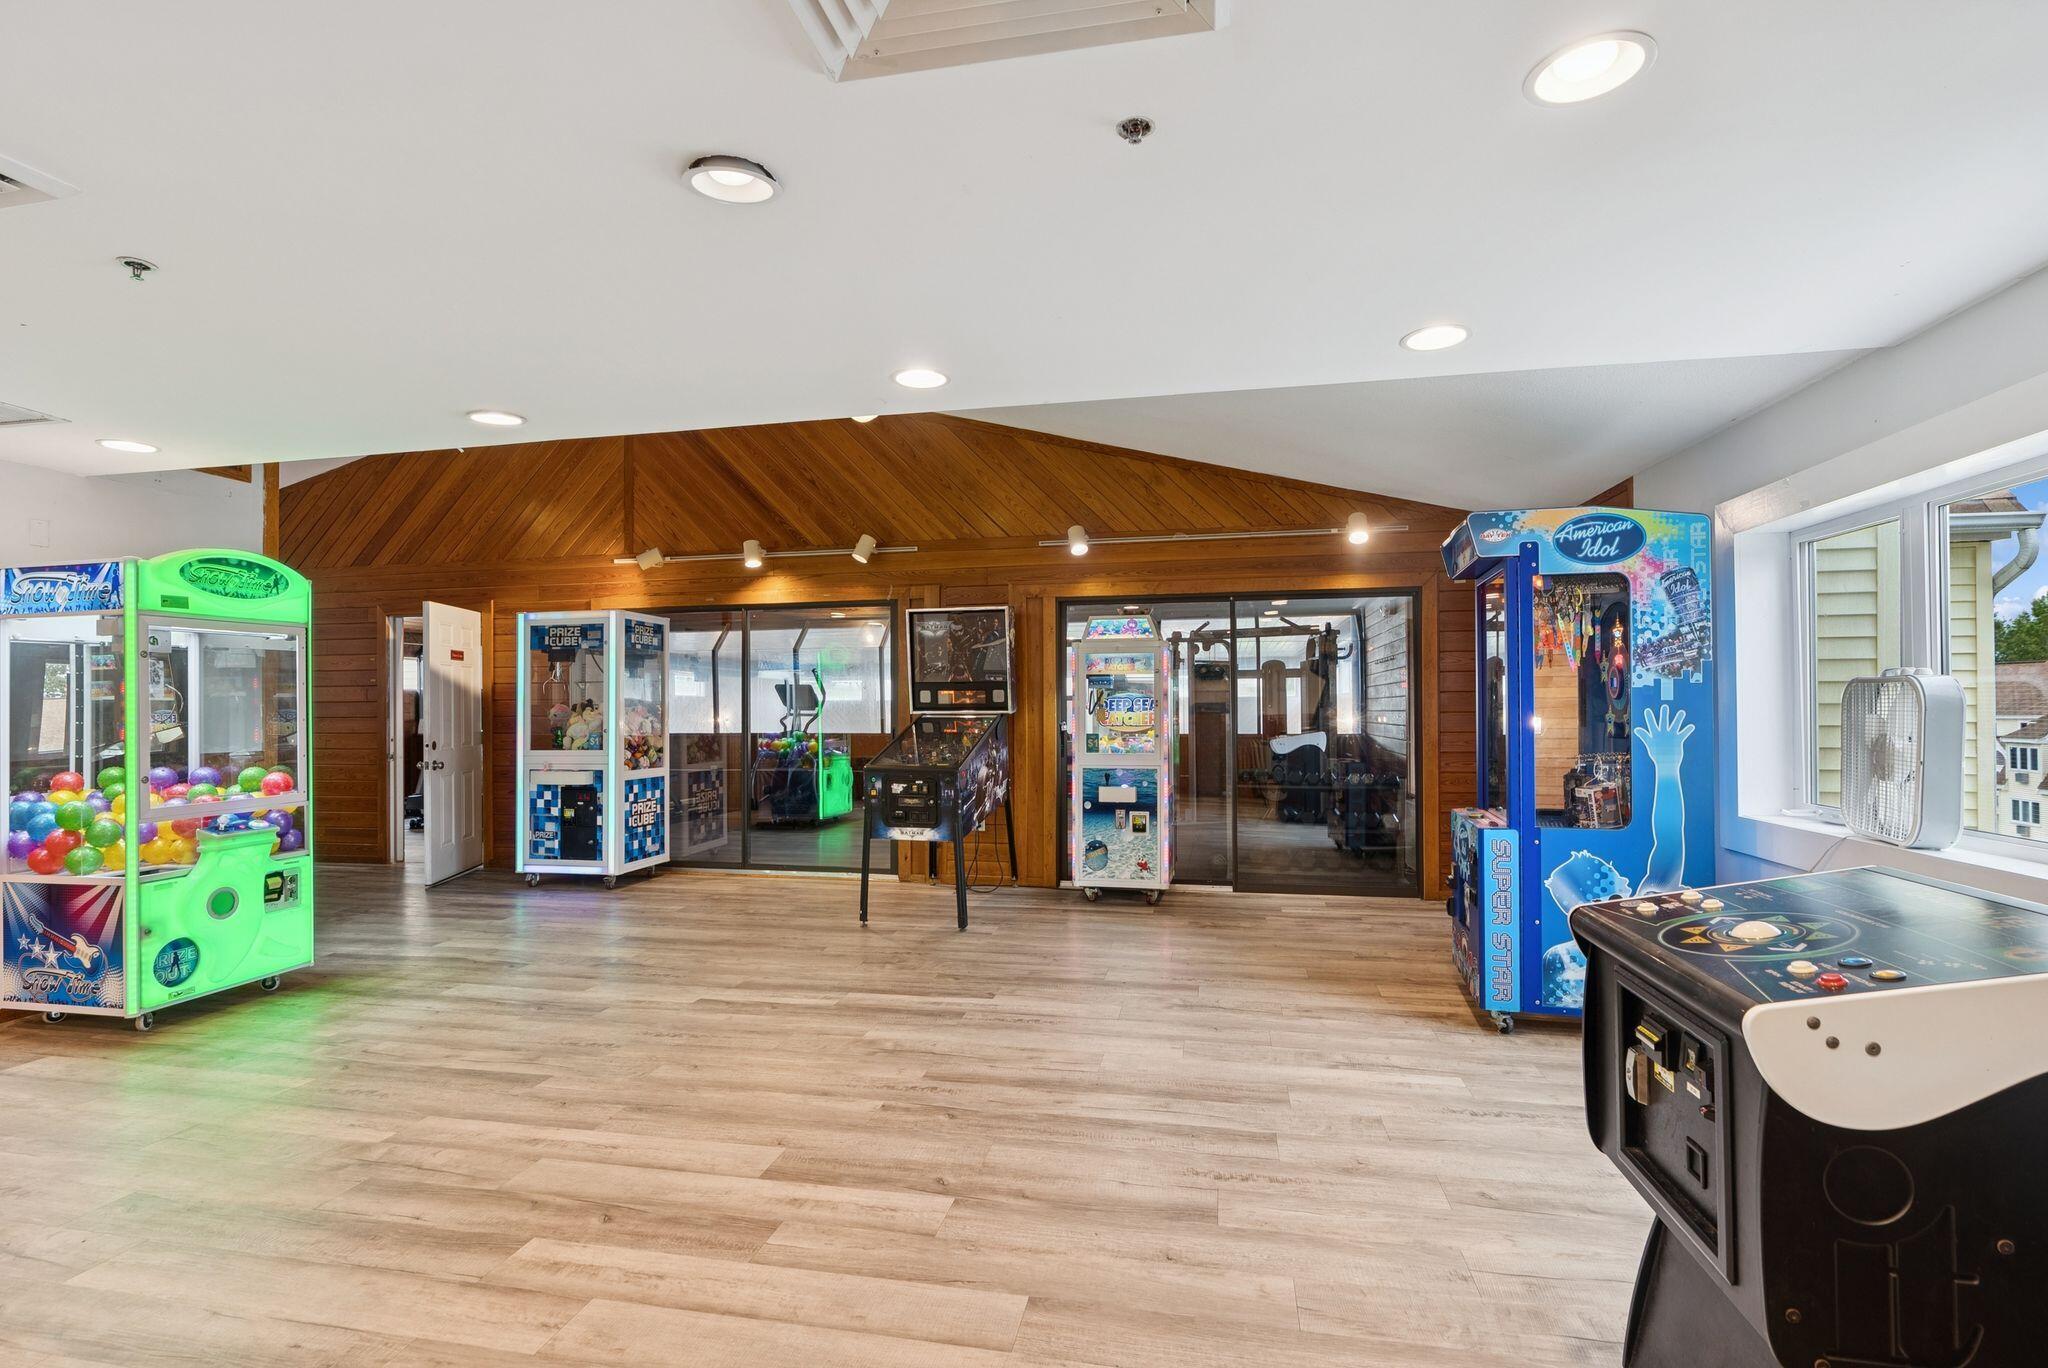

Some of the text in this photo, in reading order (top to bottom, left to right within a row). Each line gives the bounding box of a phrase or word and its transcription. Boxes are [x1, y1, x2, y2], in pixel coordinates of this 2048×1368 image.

[1554, 521, 1634, 541] American
[1576, 538, 1620, 557] Idol
[10, 572, 112, 604] Show Time
[1670, 579, 1692, 595] Idol
[549, 627, 581, 637] PRIZE
[634, 625, 654, 636] PRIZE
[549, 636, 578, 647] CUBE
[634, 635, 653, 646] CUBE
[632, 801, 658, 816] PRIZE
[632, 813, 655, 828] CUBE
[535, 831, 554, 839] PRIZE
[1491, 839, 1512, 1002] SUPER STAR
[157, 946, 197, 968] RIZE
[22, 966, 101, 994] Show Time
